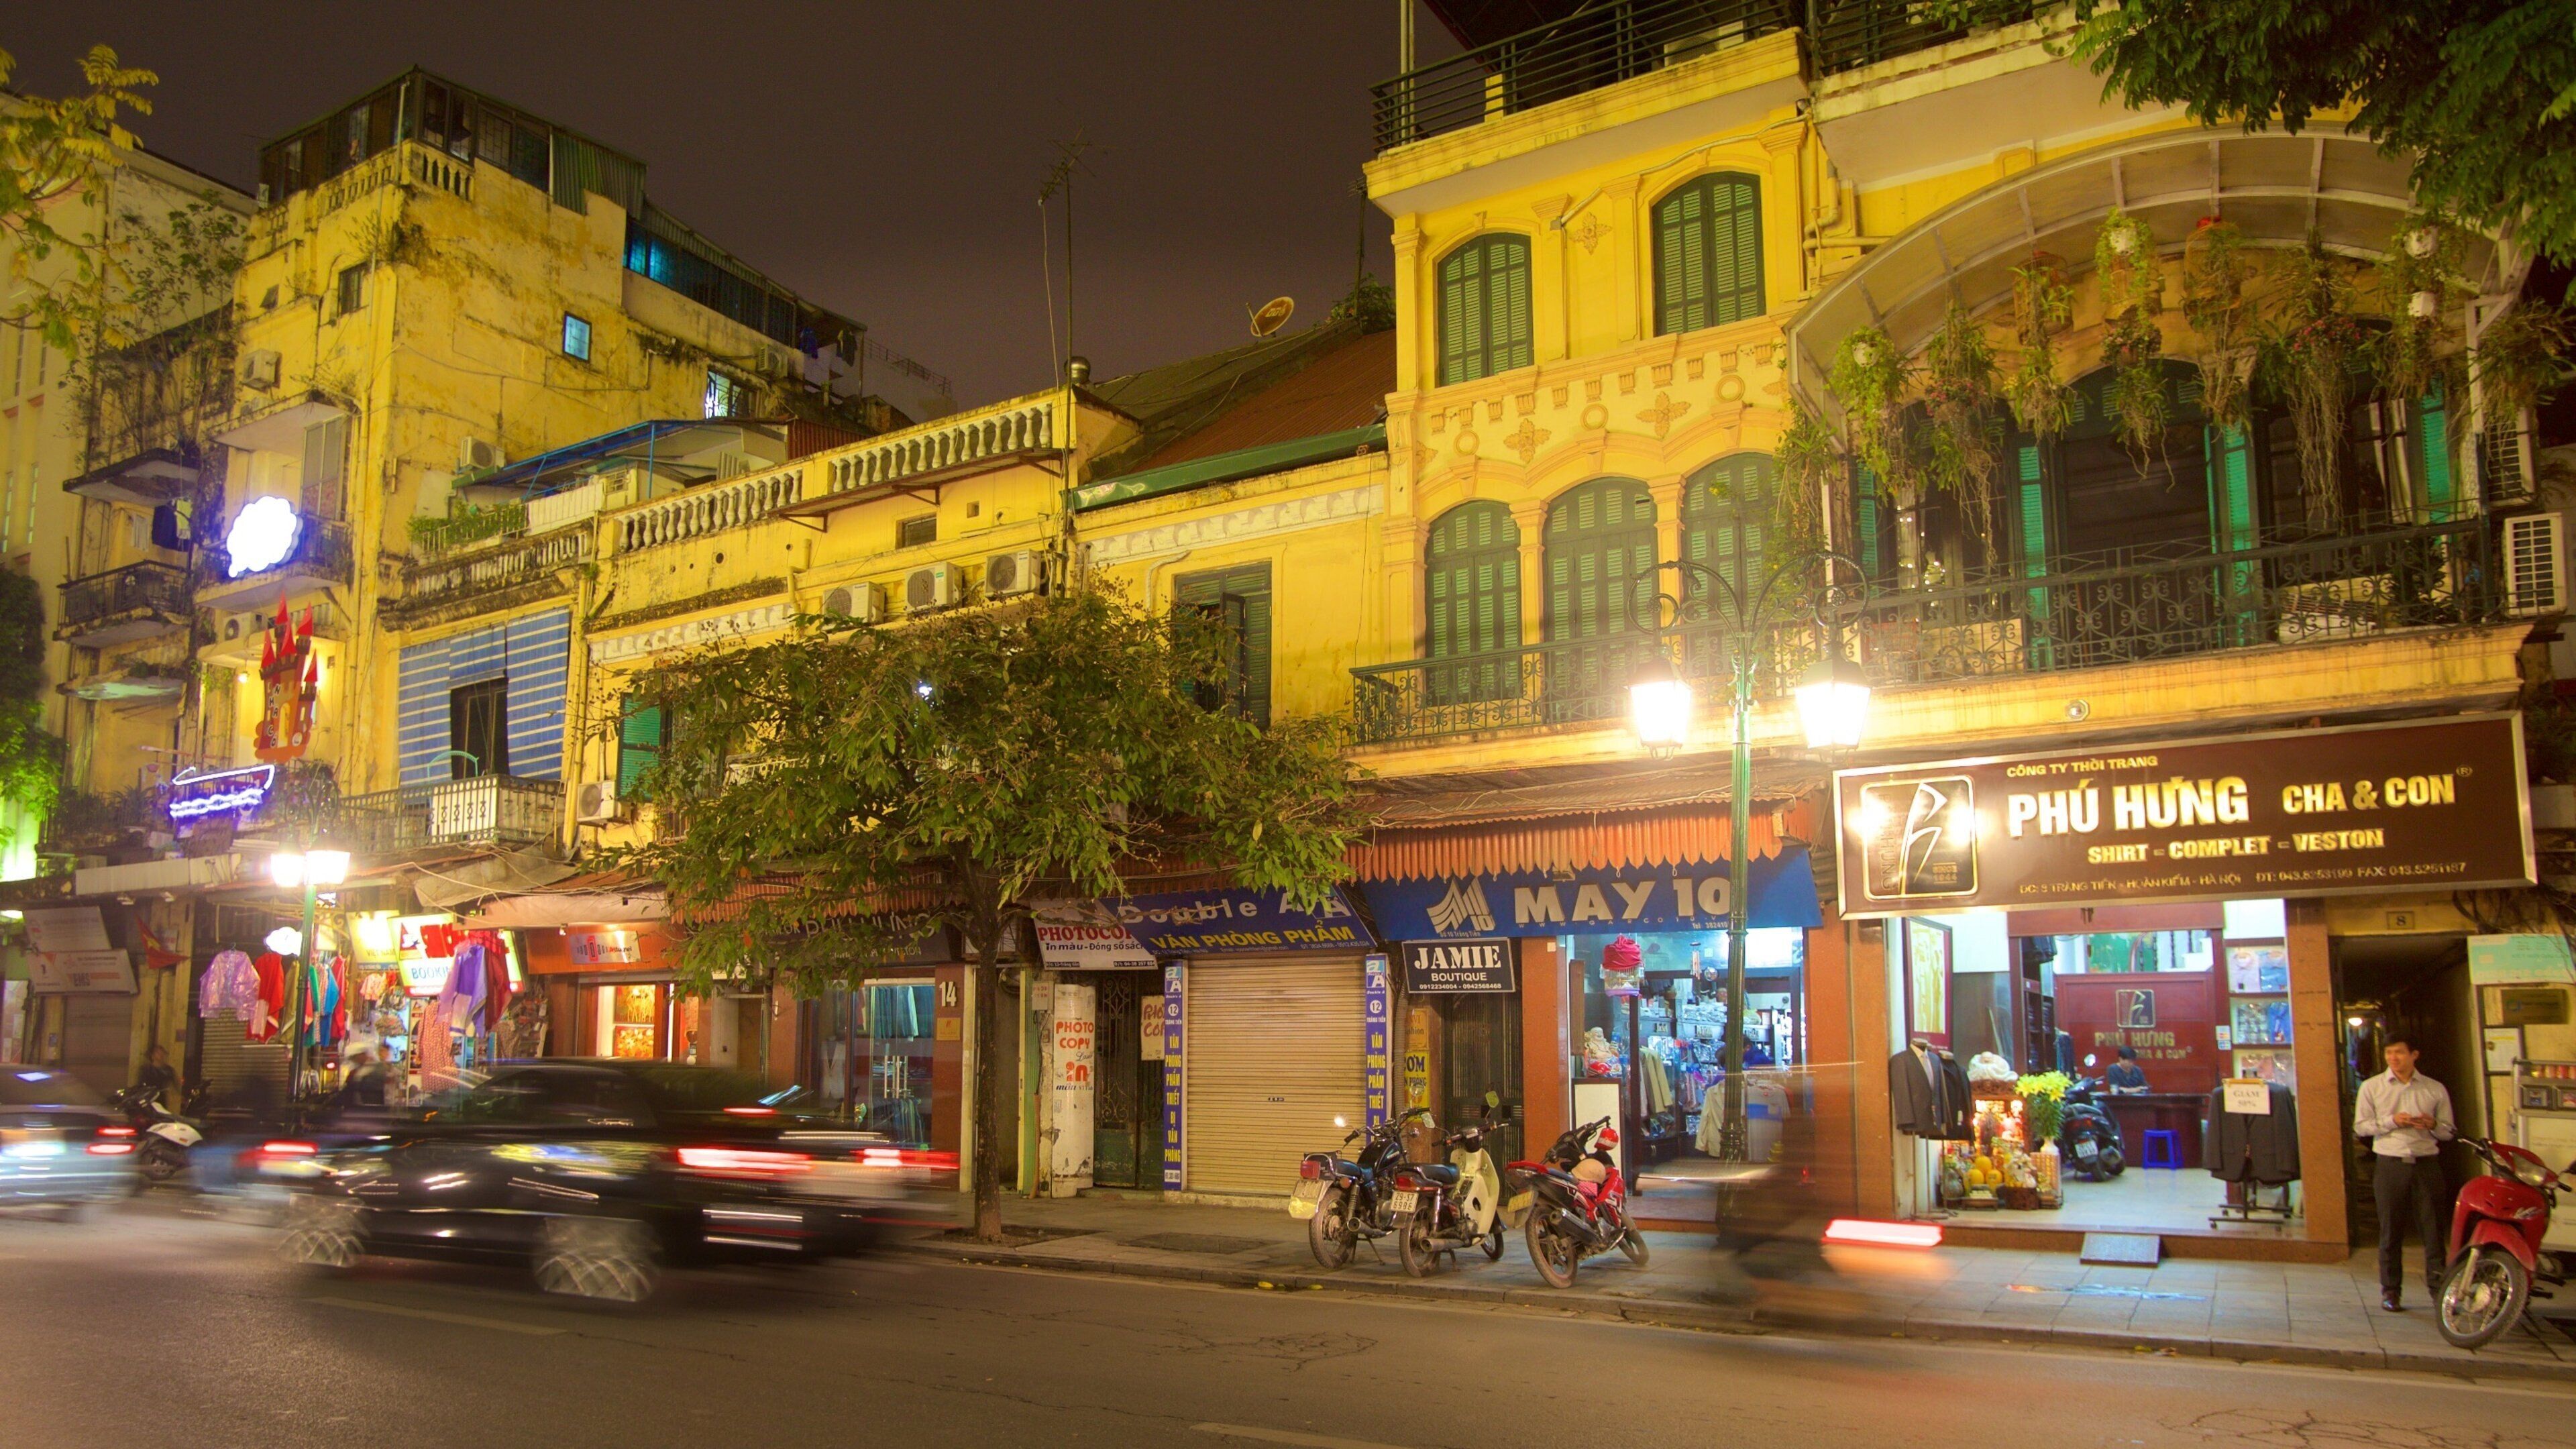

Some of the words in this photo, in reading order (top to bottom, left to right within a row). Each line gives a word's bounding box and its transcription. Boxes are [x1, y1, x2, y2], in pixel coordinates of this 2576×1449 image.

[2007, 762, 2046, 777] CÔNG
[2049, 763, 2068, 774] TY
[2071, 757, 2104, 773] THỜI
[2107, 755, 2158, 769] TRANG
[2282, 782, 2348, 814] CHA
[2353, 780, 2380, 810] &
[2385, 774, 2455, 808] CON
[2008, 778, 2100, 838] PHÚ
[2112, 776, 2249, 830] HƯNG
[2088, 844, 2149, 864] SHIRT
[2169, 835, 2271, 860] COMPLET
[2292, 828, 2385, 852] VESTON
[1514, 880, 1656, 924] MAY
[1672, 876, 1731, 916] 10
[1149, 931, 1201, 949] VĂN
[1203, 929, 1282, 947] PHÒNG
[1284, 920, 1355, 943] PHẨM
[1089, 941, 1112, 951] Đóng
[1414, 945, 1501, 970] JAMIE
[1431, 973, 1487, 981] BOUTIQUE
[939, 981, 957, 1007] 14
[1170, 1006, 1177, 1014] 12
[1372, 1003, 1380, 1011] 12
[1056, 1021, 1094, 1034] PHOTO
[1059, 1037, 1090, 1050] COPY
[1367, 1051, 1385, 1068] PHÒNG
[1404, 1054, 1425, 1072] ƠM
